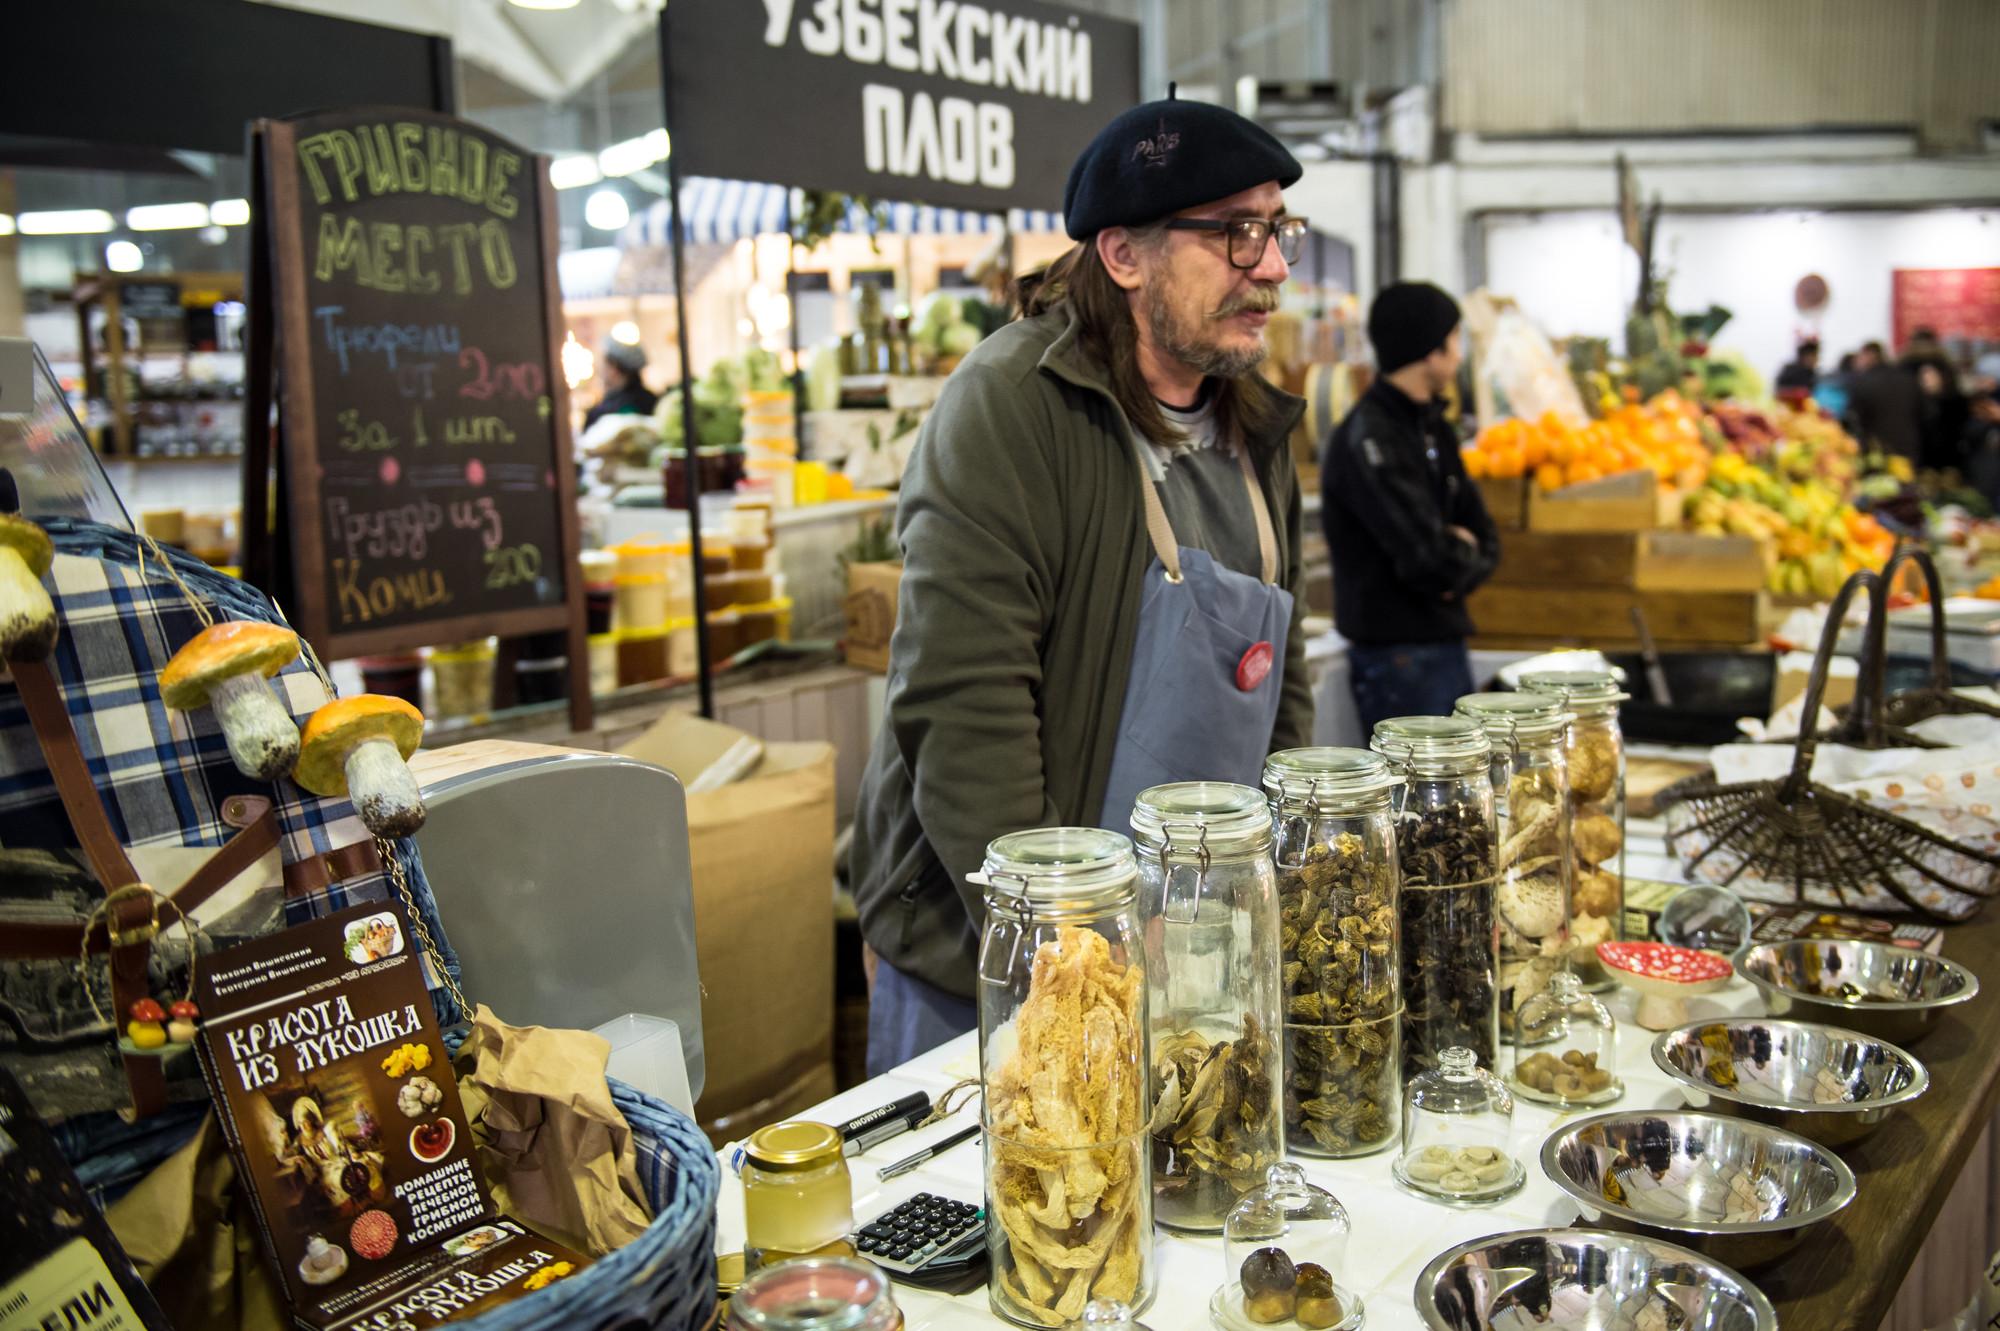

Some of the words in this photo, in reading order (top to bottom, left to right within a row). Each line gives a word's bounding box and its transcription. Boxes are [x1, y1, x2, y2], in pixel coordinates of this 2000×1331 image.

[761, 0, 1092, 103] УЗБЕКСКИЙ
[862, 83, 1015, 189] ПЛОВ
[297, 122, 521, 219] ГРИБНОЕ
[313, 213, 518, 295] МЕСТО
[314, 305, 460, 374] Трюфели
[484, 543, 542, 589] 200
[225, 995, 355, 1061] КРАСОТА
[236, 1053, 280, 1091] ИЗ
[293, 1004, 423, 1073] ЛУКОШКА
[848, 1108, 887, 1130] DIAMOND
[394, 1158, 470, 1199] ДОМАШНИЕ
[407, 1169, 473, 1204] РЕЦЕПТЫ
[411, 1179, 477, 1217] ЛЕЧЕБНОЙ
[413, 1191, 480, 1228] ГРИБНОЙ
[407, 1203, 485, 1244] КОСМЕТИКИ
[350, 1270, 479, 1331] КРАСОТА
[424, 1250, 554, 1320] ЛУКОШКА
